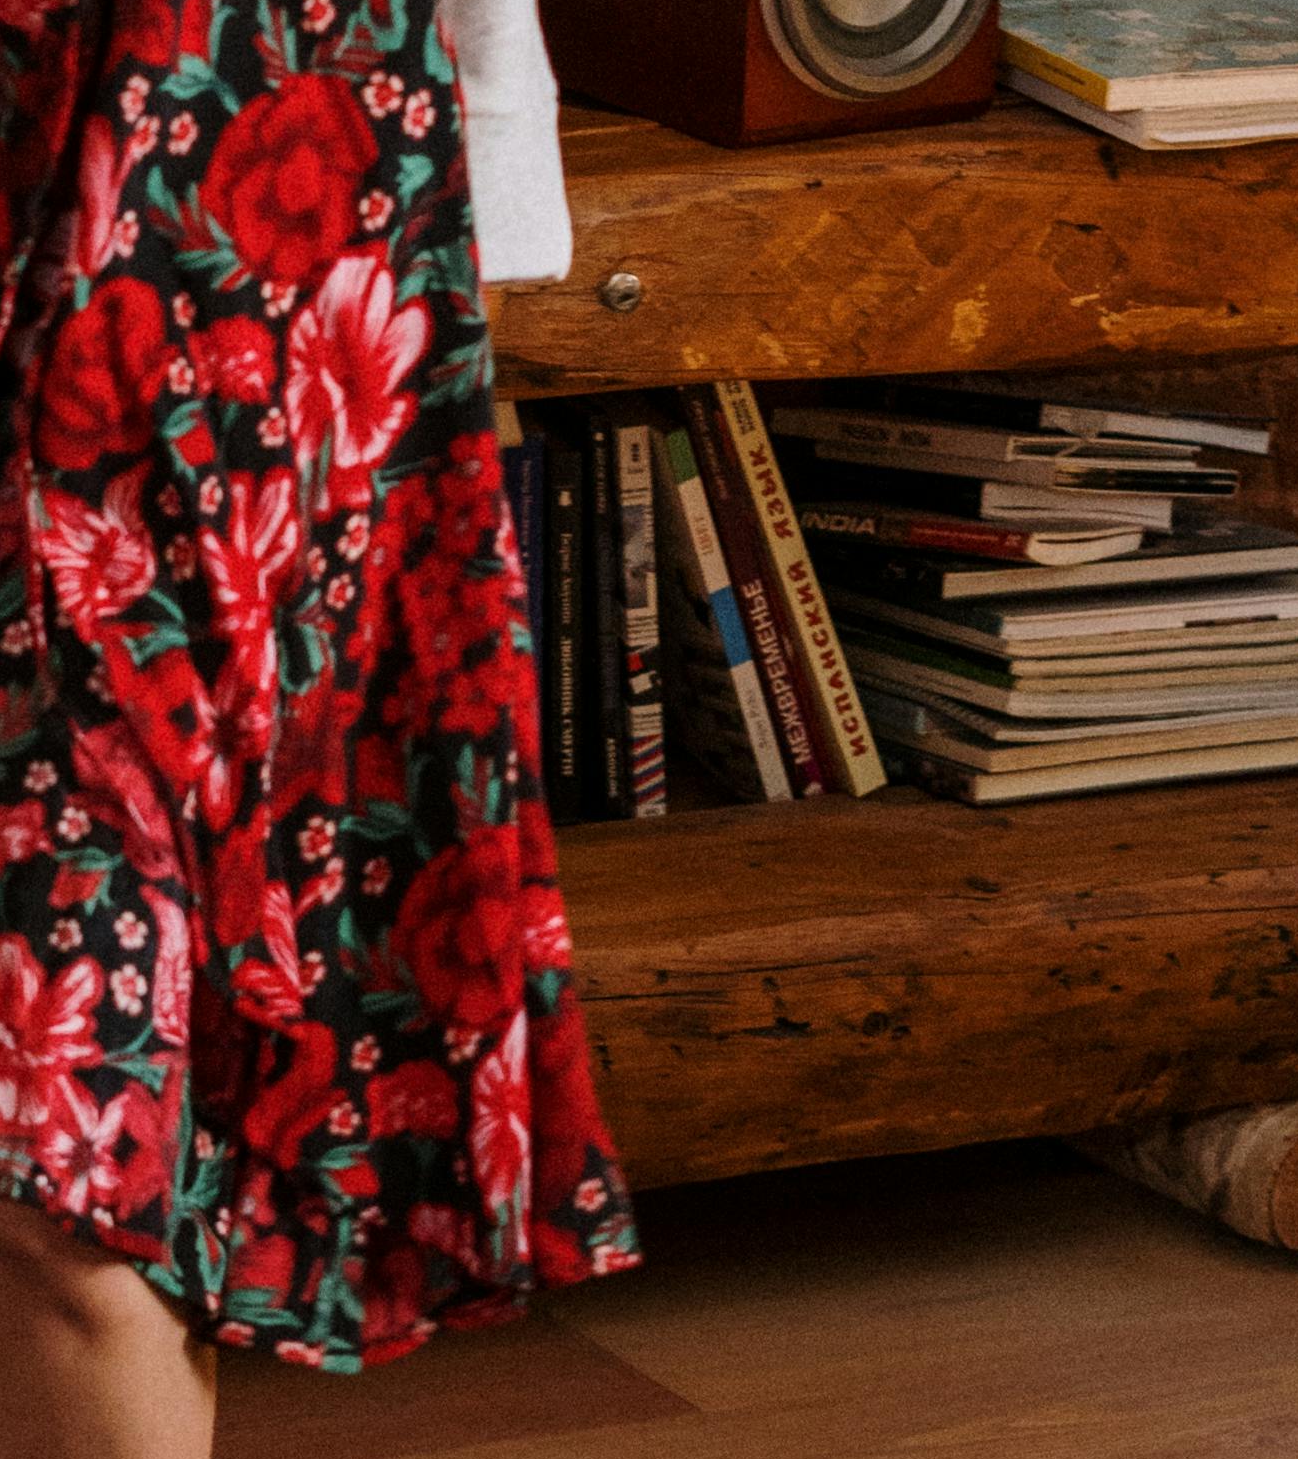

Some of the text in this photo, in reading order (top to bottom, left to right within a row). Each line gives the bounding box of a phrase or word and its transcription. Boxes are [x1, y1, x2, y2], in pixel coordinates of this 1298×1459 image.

[746, 442, 870, 758] ИСПАНСКИЙ ЯЗЫК
[799, 512, 878, 536] INDIA
[739, 577, 813, 766] МЕЖВРЕМЕНЬЕ
